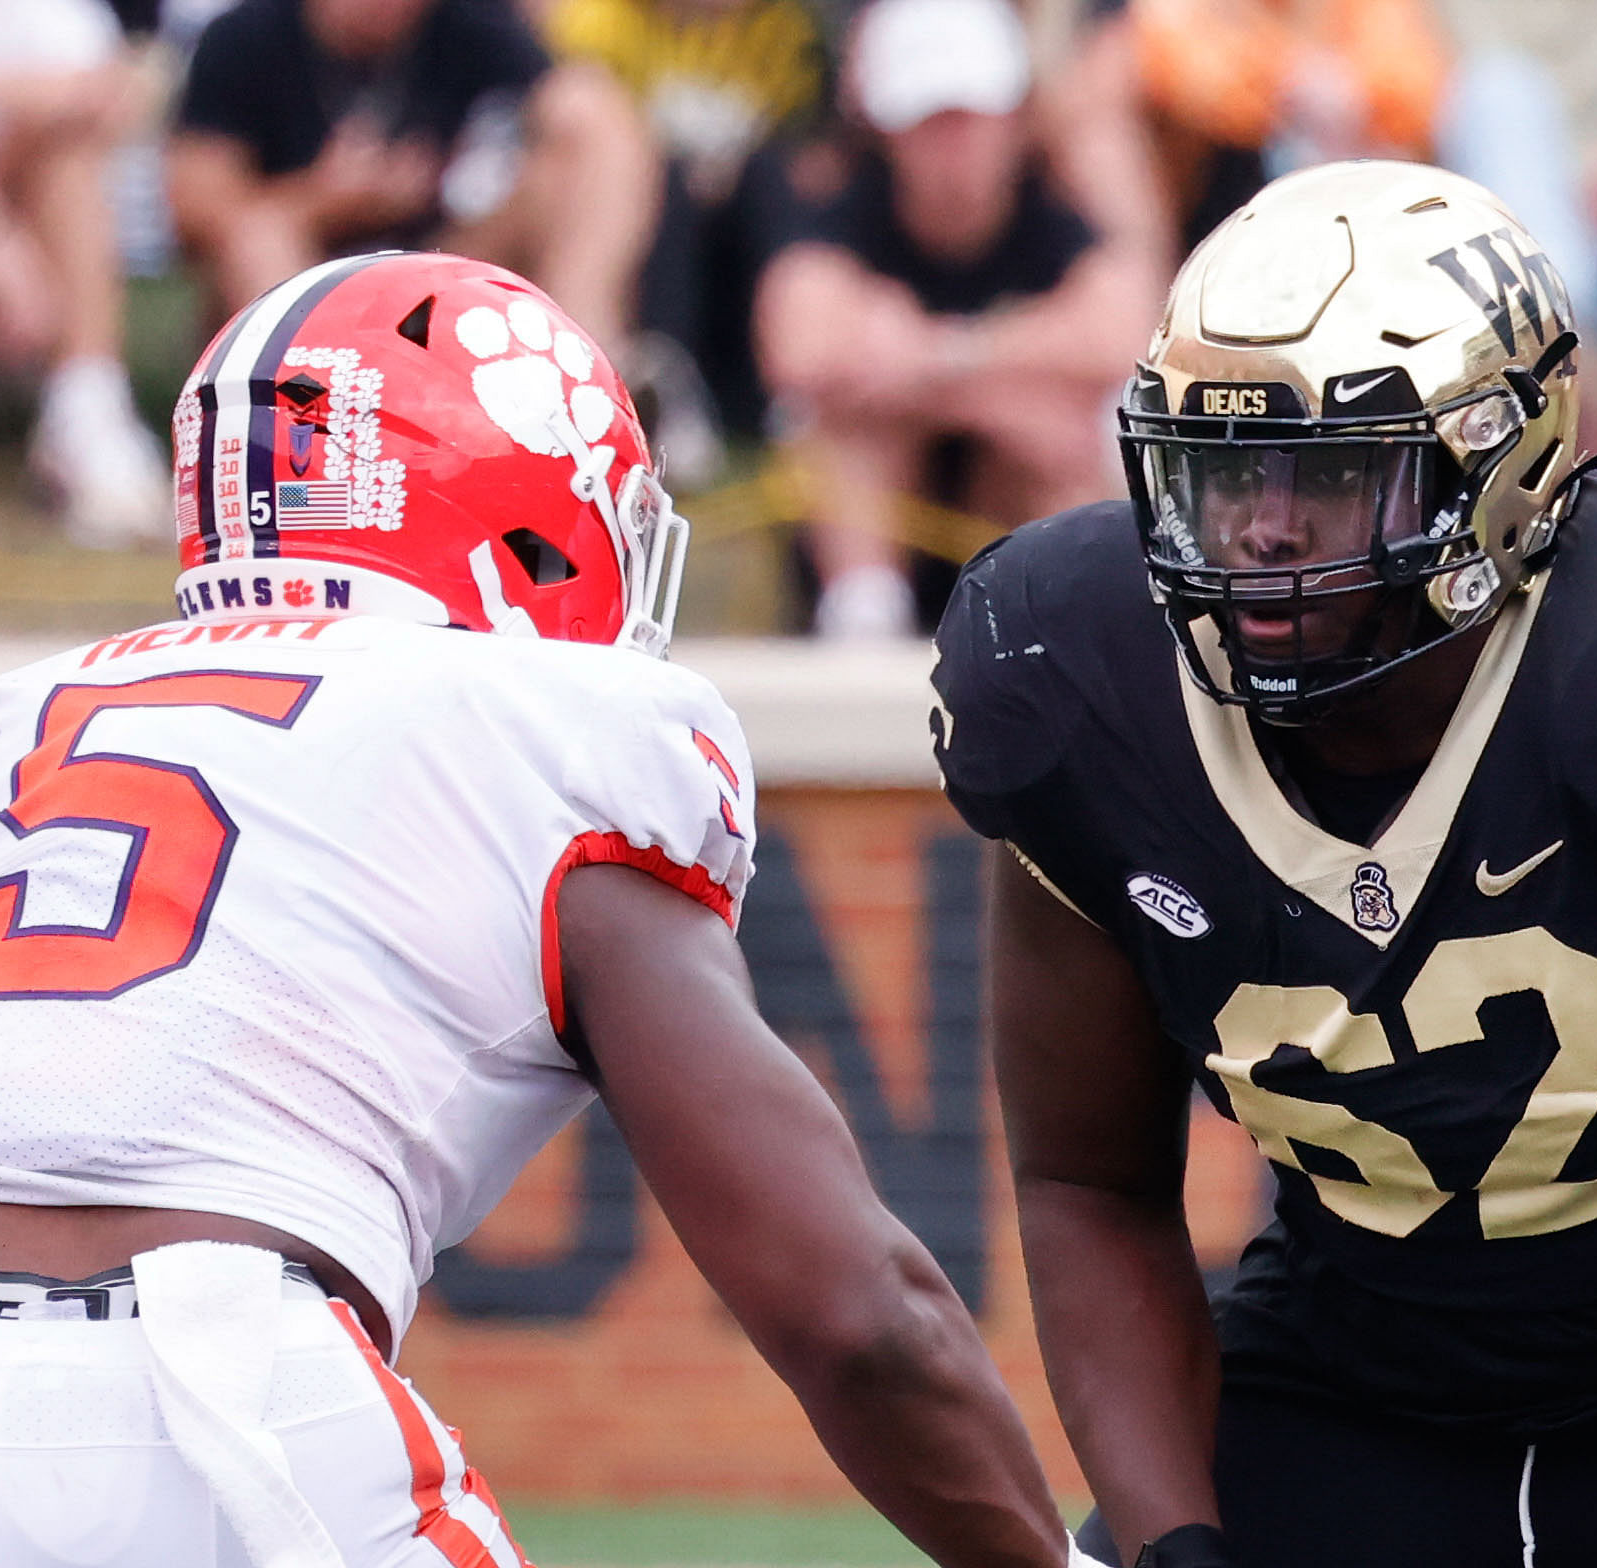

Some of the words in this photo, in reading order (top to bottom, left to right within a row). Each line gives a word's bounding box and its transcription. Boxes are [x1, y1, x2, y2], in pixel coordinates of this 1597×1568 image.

[1203, 389, 1266, 415] DEACS
[249, 490, 271, 525] 5
[1163, 494, 1205, 567] Riddel
[1249, 674, 1297, 692] Riddell
[1137, 887, 1195, 927] ACC
